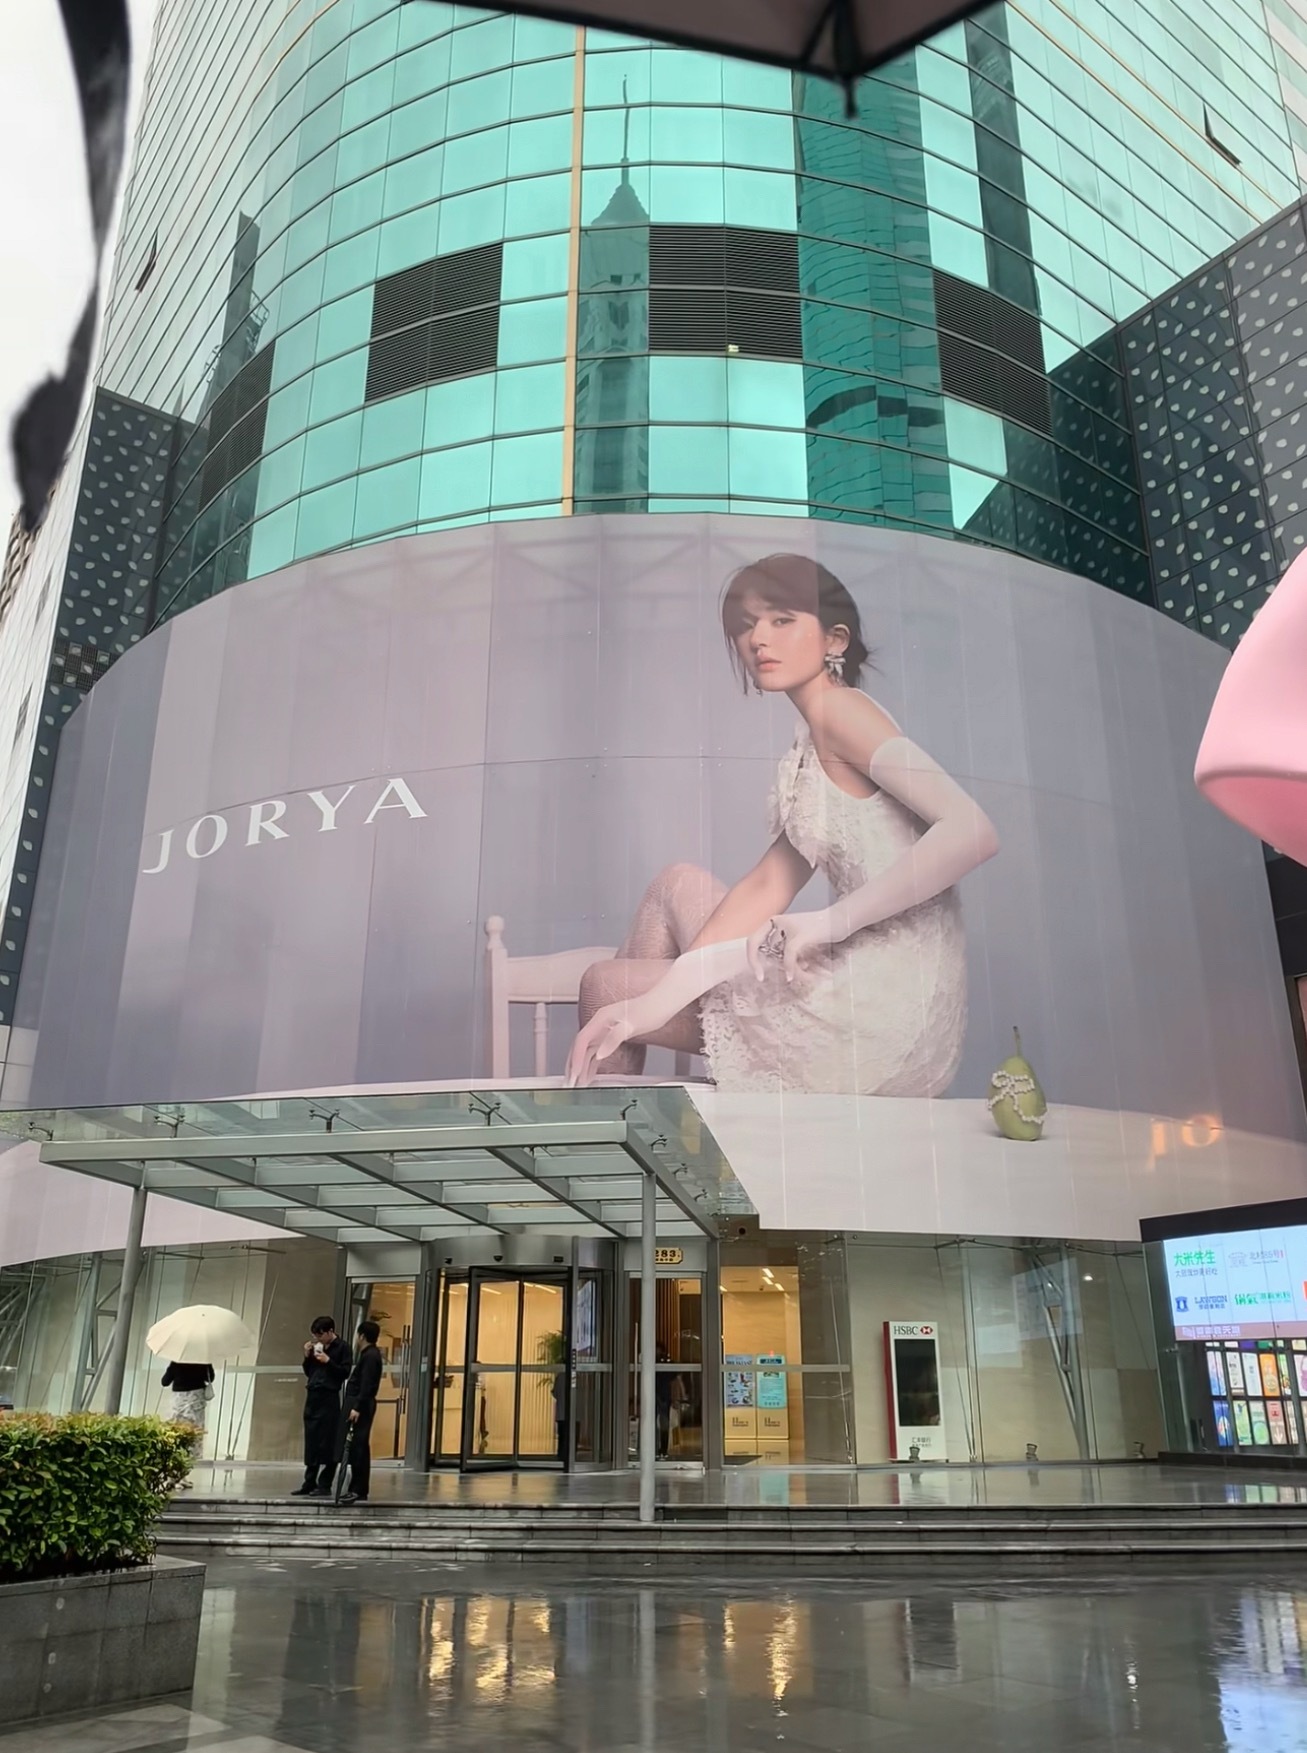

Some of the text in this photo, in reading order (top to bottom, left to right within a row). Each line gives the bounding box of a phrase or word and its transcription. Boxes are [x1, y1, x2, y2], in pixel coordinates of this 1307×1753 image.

[142, 777, 428, 874] JORYA
[1174, 1250, 1216, 1267] 大米先生
[893, 1326, 918, 1335] HSBC
